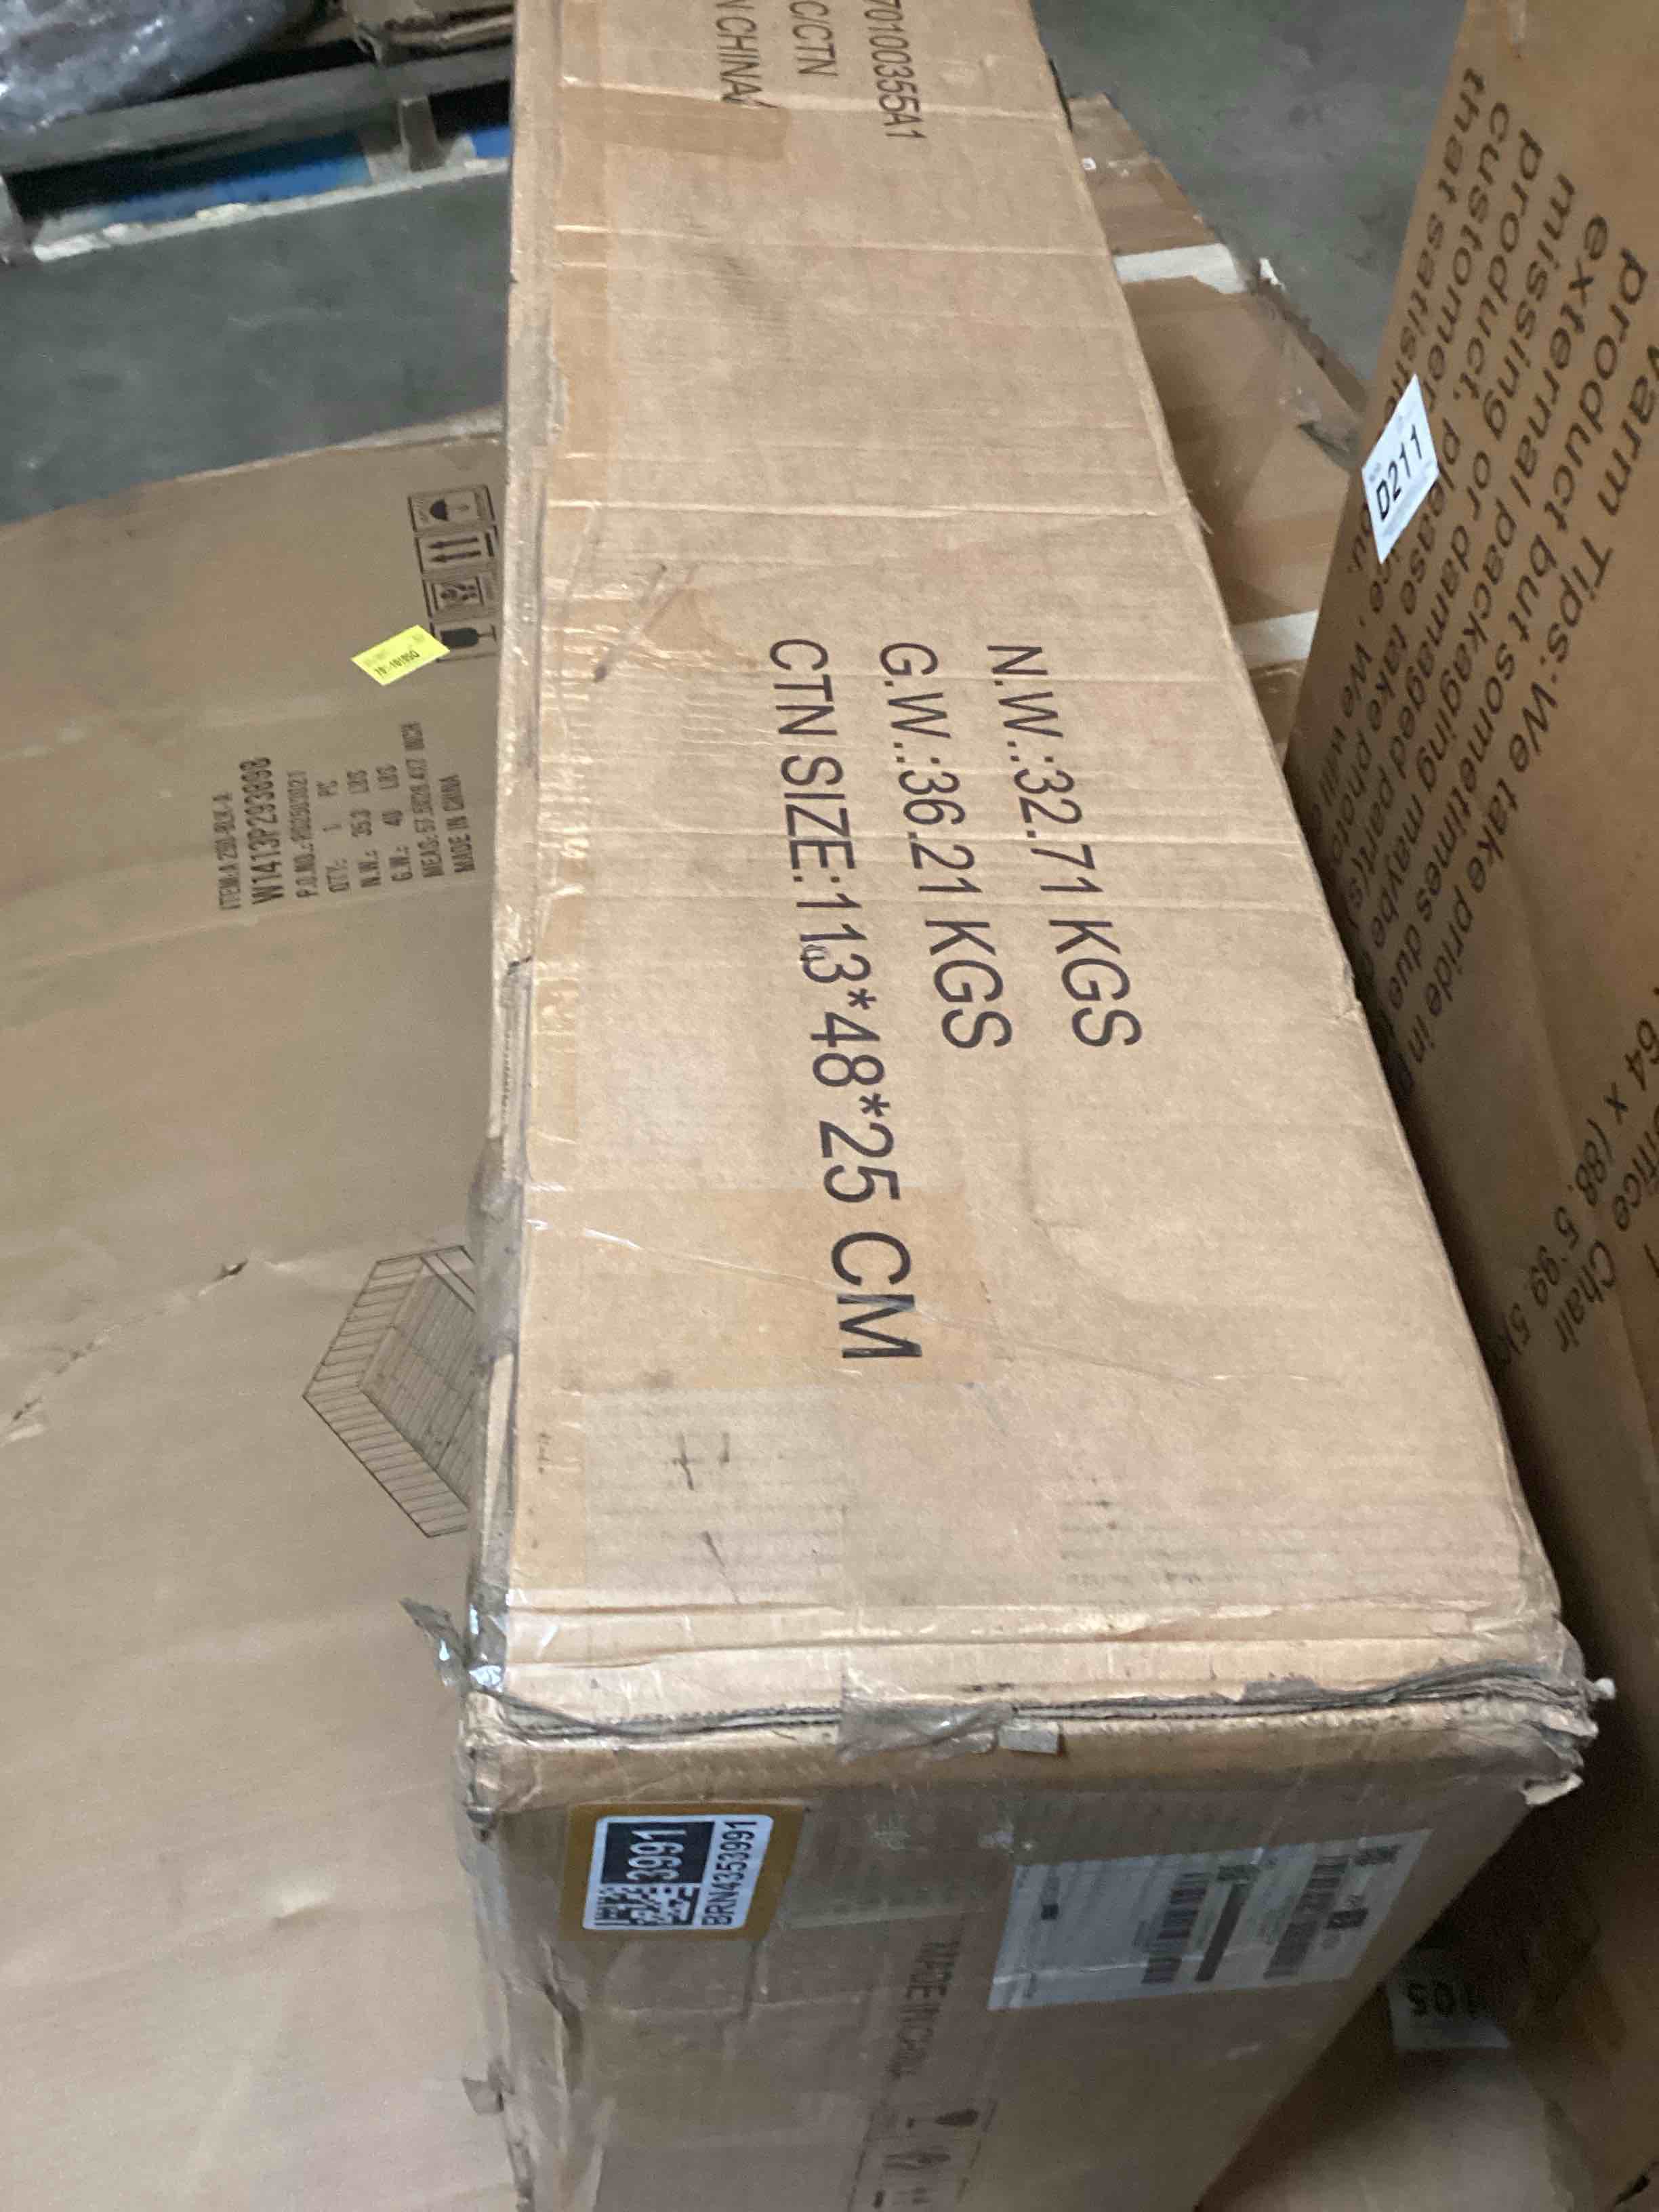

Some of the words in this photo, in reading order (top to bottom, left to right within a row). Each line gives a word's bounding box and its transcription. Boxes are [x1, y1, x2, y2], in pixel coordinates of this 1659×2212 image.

[716, 16, 764, 105] CHINA
[1438, 66, 1486, 205] that
[1422, 101, 1511, 414] customer
[1483, 174, 1577, 443] missing
[1507, 213, 1609, 510] external
[1544, 247, 1649, 534] product
[1466, 450, 1492, 522] or
[1595, 346, 1659, 517] arm
[1400, 416, 1461, 615] please
[1390, 525, 1471, 778] damaged
[1417, 498, 1518, 793] packaging
[1508, 534, 1559, 642] but
[1340, 642, 1374, 718] We
[1366, 623, 1409, 732] take
[439, 775, 466, 812] CHINA
[445, 815, 470, 832] IN
[1416, 643, 1518, 923] sometimes
[1468, 778, 1520, 894] take
[448, 834, 475, 874] MADE
[1372, 792, 1425, 947] maybe
[769, 639, 838, 736] CTN
[830, 1231, 922, 1359] CM
[924, 920, 1013, 1048] KGS
[1048, 919, 1143, 1047] KGS
[1388, 920, 1422, 1012] due
[1427, 884, 1474, 1018] pride
[1408, 1019, 1437, 1065] in
[1616, 1111, 1659, 1232] ffice
[1559, 1240, 1618, 1354] Chair
[626, 1830, 688, 1882] 3991
